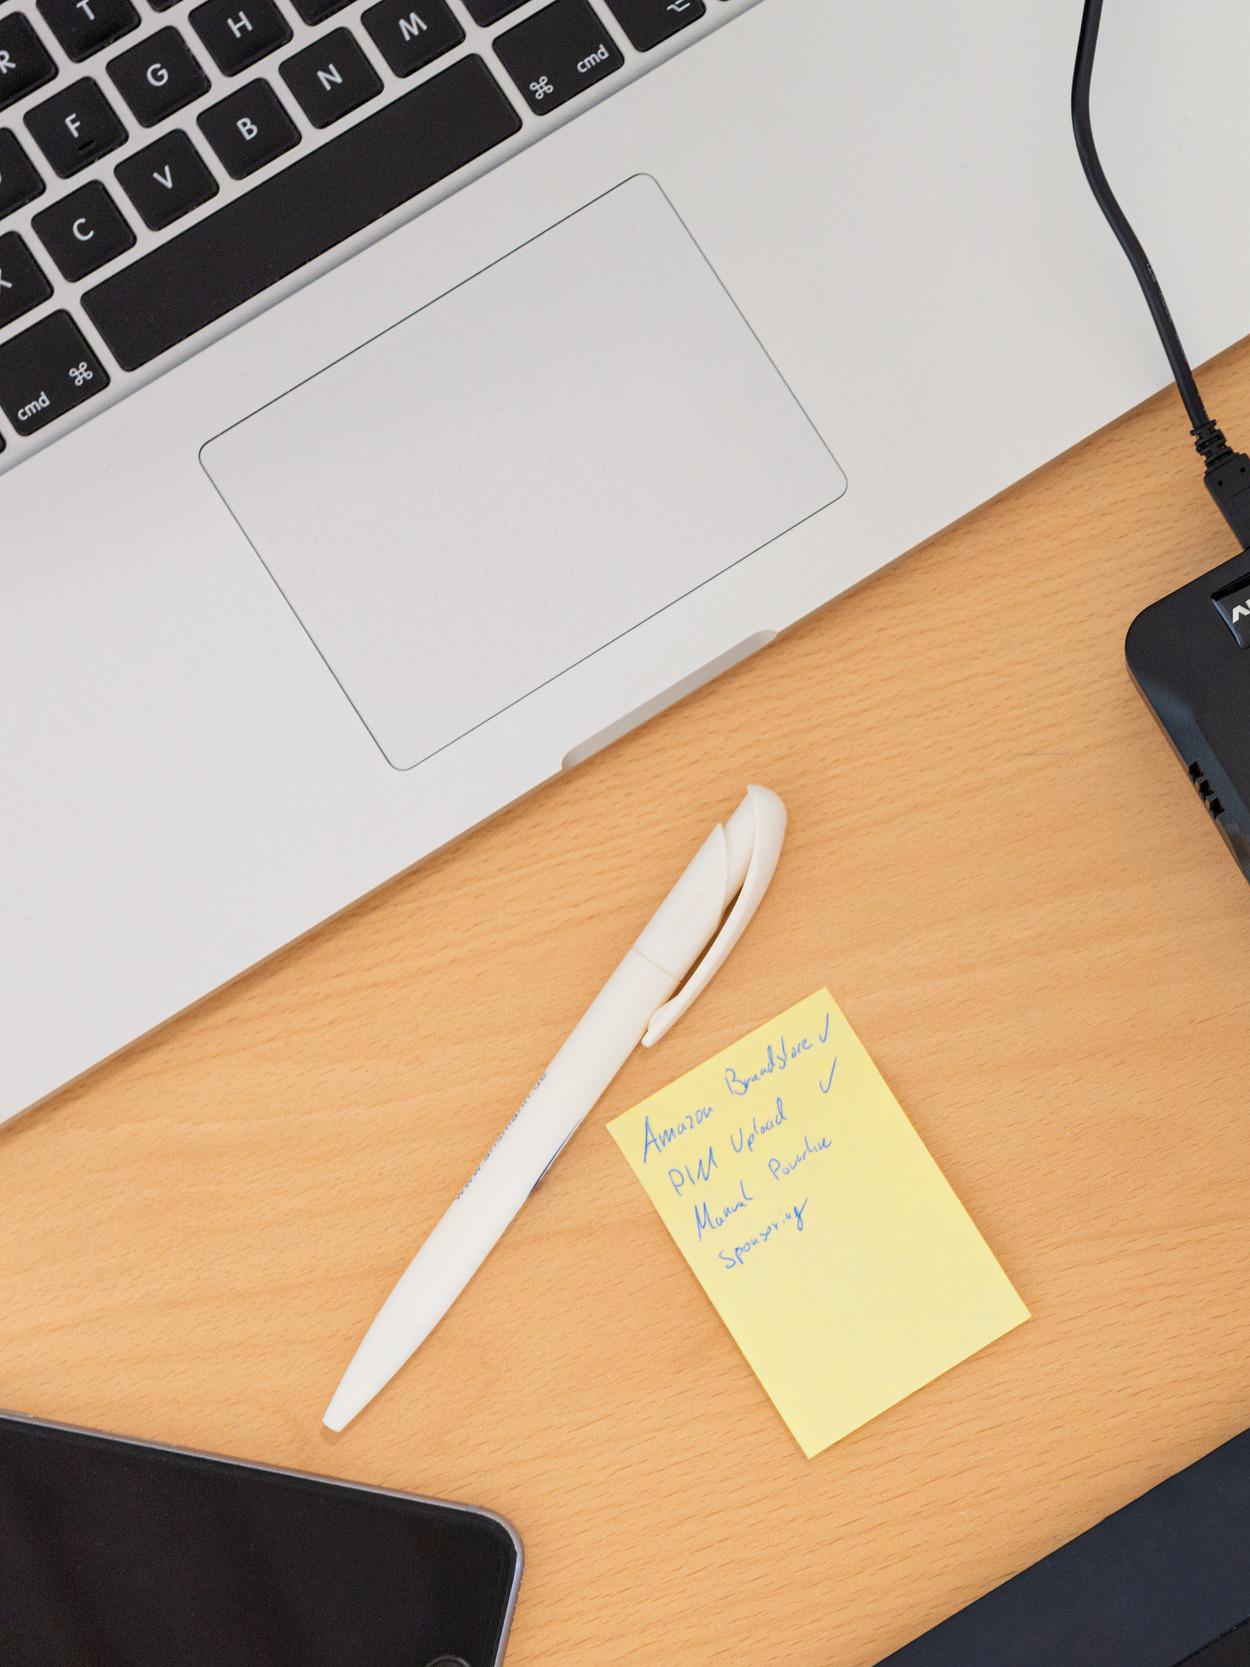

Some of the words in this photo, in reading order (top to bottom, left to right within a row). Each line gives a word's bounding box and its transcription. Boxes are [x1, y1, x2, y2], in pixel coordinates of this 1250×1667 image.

[76, 0, 95, 21] T
[226, 10, 254, 39] H
[399, 12, 428, 41] M
[576, 44, 610, 74] cmd
[146, 63, 169, 87] G
[316, 63, 344, 91] N
[64, 113, 81, 138] F
[236, 117, 259, 141] B
[152, 165, 174, 189] V
[72, 217, 95, 241] C
[17, 391, 51, 421] cmd
[643, 1105, 714, 1164] Amazon
[725, 1036, 813, 1096] Brandstore
[730, 1097, 788, 1153] Upload
